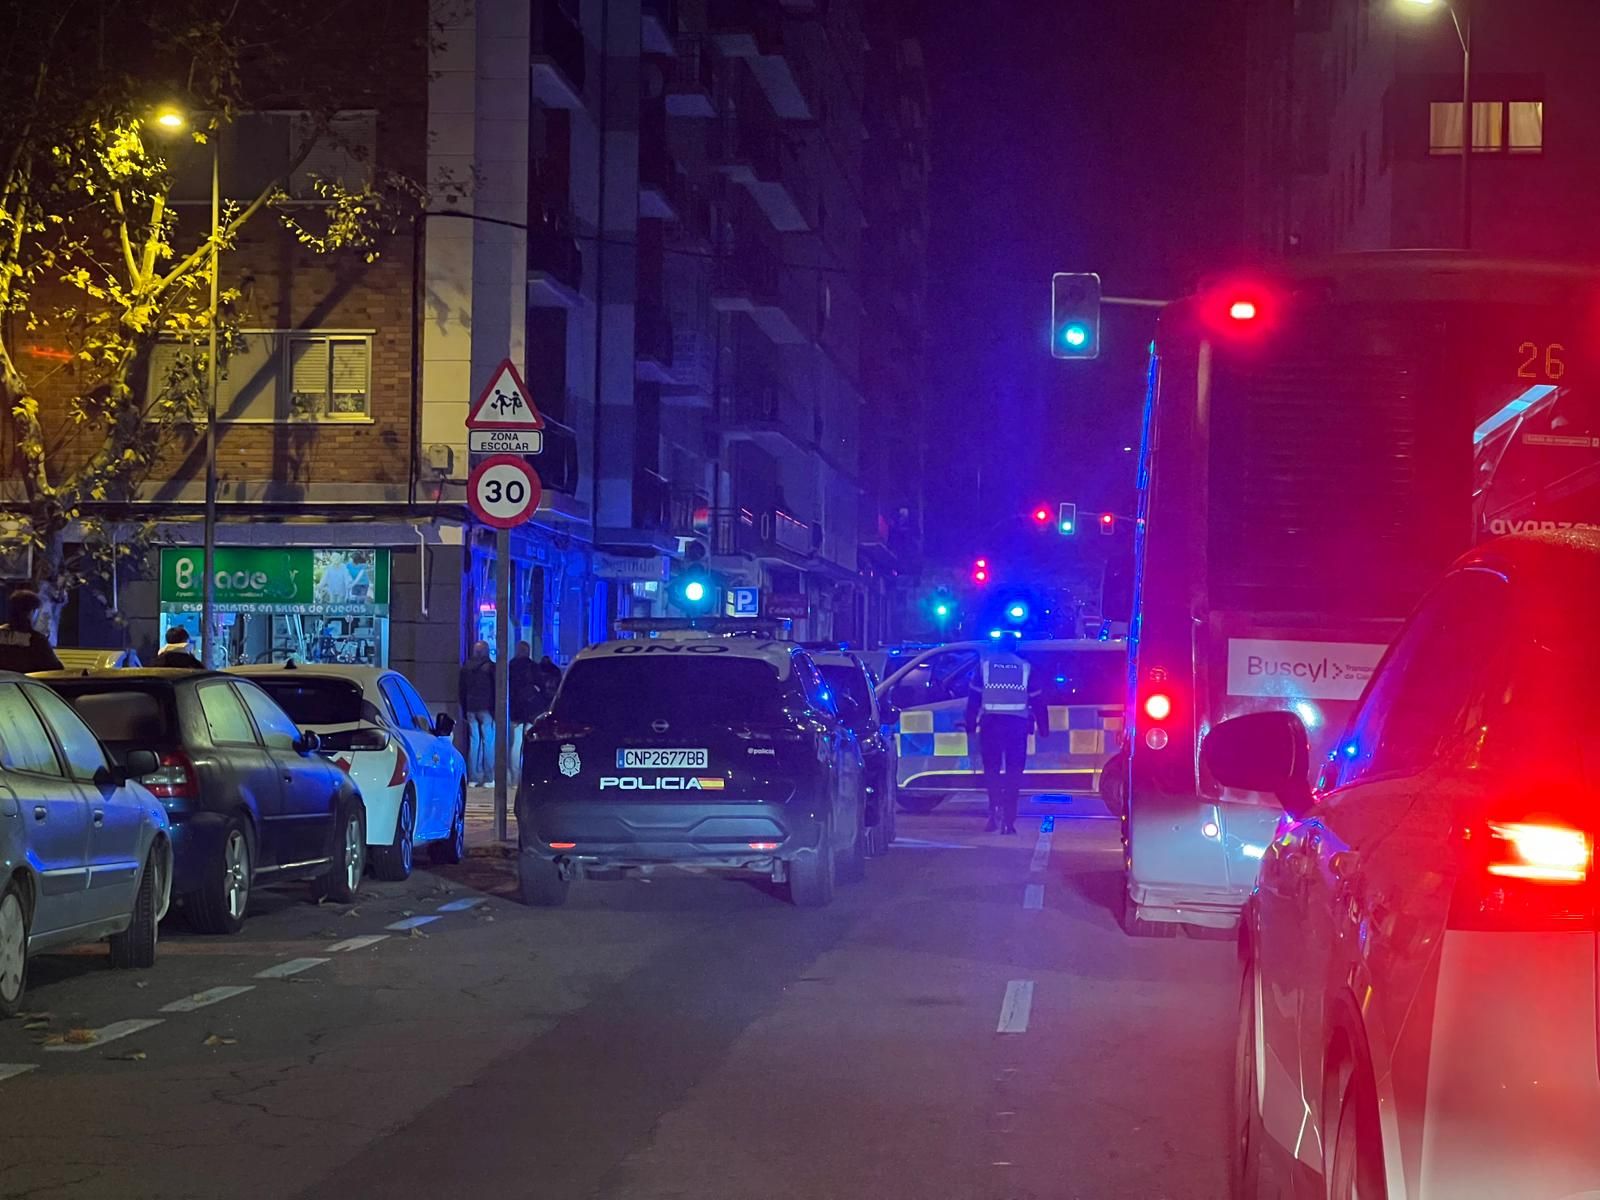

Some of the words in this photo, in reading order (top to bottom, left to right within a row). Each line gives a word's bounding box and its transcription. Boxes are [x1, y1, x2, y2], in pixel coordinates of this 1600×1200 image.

[1517, 341, 1565, 380] 26
[490, 432, 519, 441] ZONA
[480, 442, 529, 451] ESCOLAR
[485, 480, 525, 504] 30
[737, 590, 753, 611] P
[308, 604, 324, 613] de
[325, 604, 366, 614] ruedas
[1247, 655, 1328, 683] Buscyl
[625, 751, 705, 766] CNP2677BB
[600, 777, 702, 790] POLICIA
